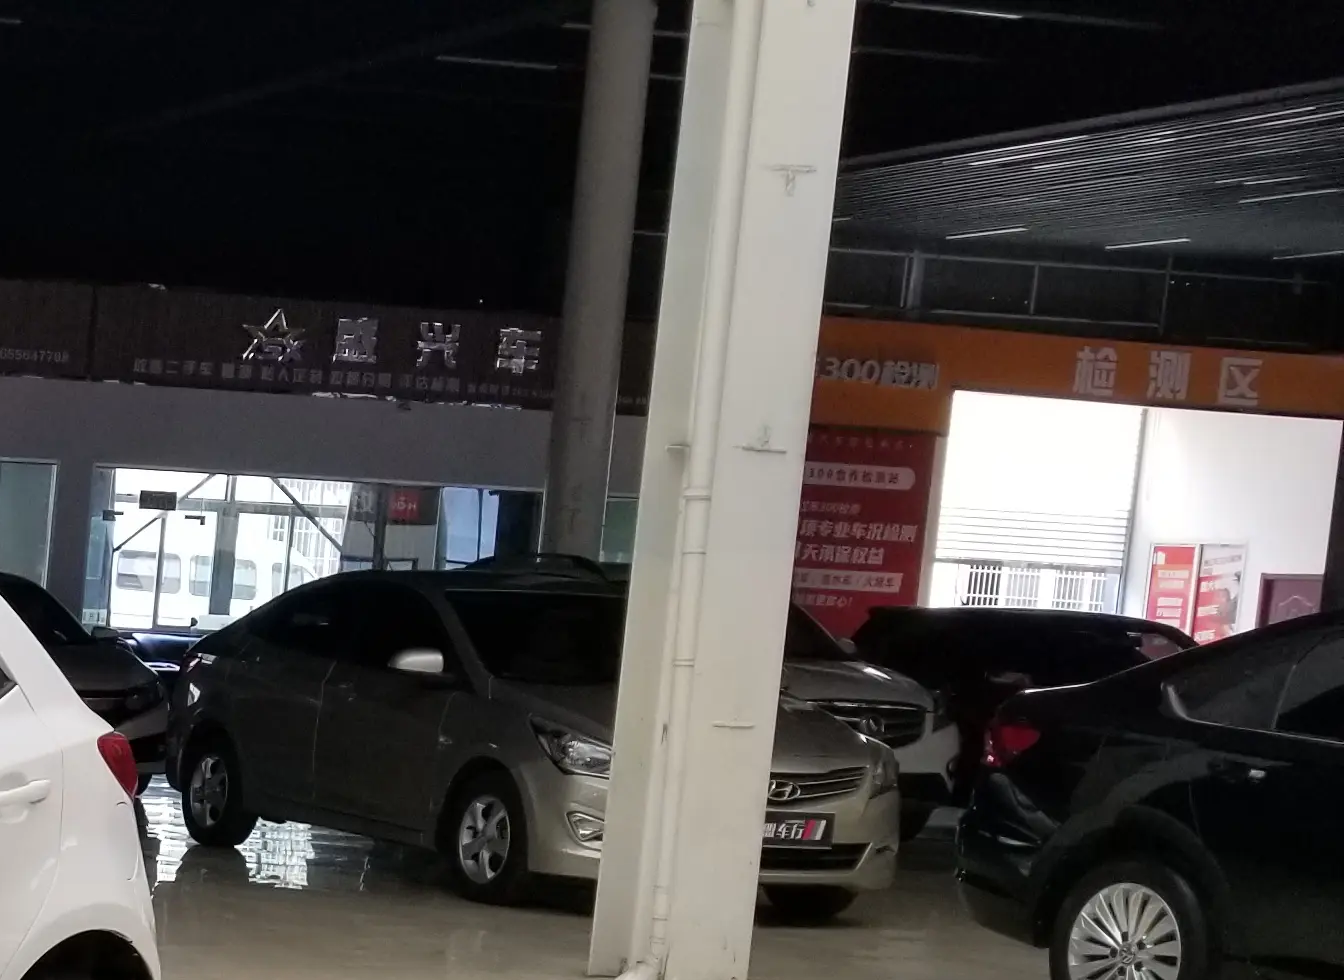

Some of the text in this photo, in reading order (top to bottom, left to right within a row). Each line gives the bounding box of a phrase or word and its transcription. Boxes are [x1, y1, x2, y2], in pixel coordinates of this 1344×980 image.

[816, 356, 939, 389] 300检测
[1073, 346, 1263, 405] 检测区
[805, 467, 900, 484] 300合作检测站
